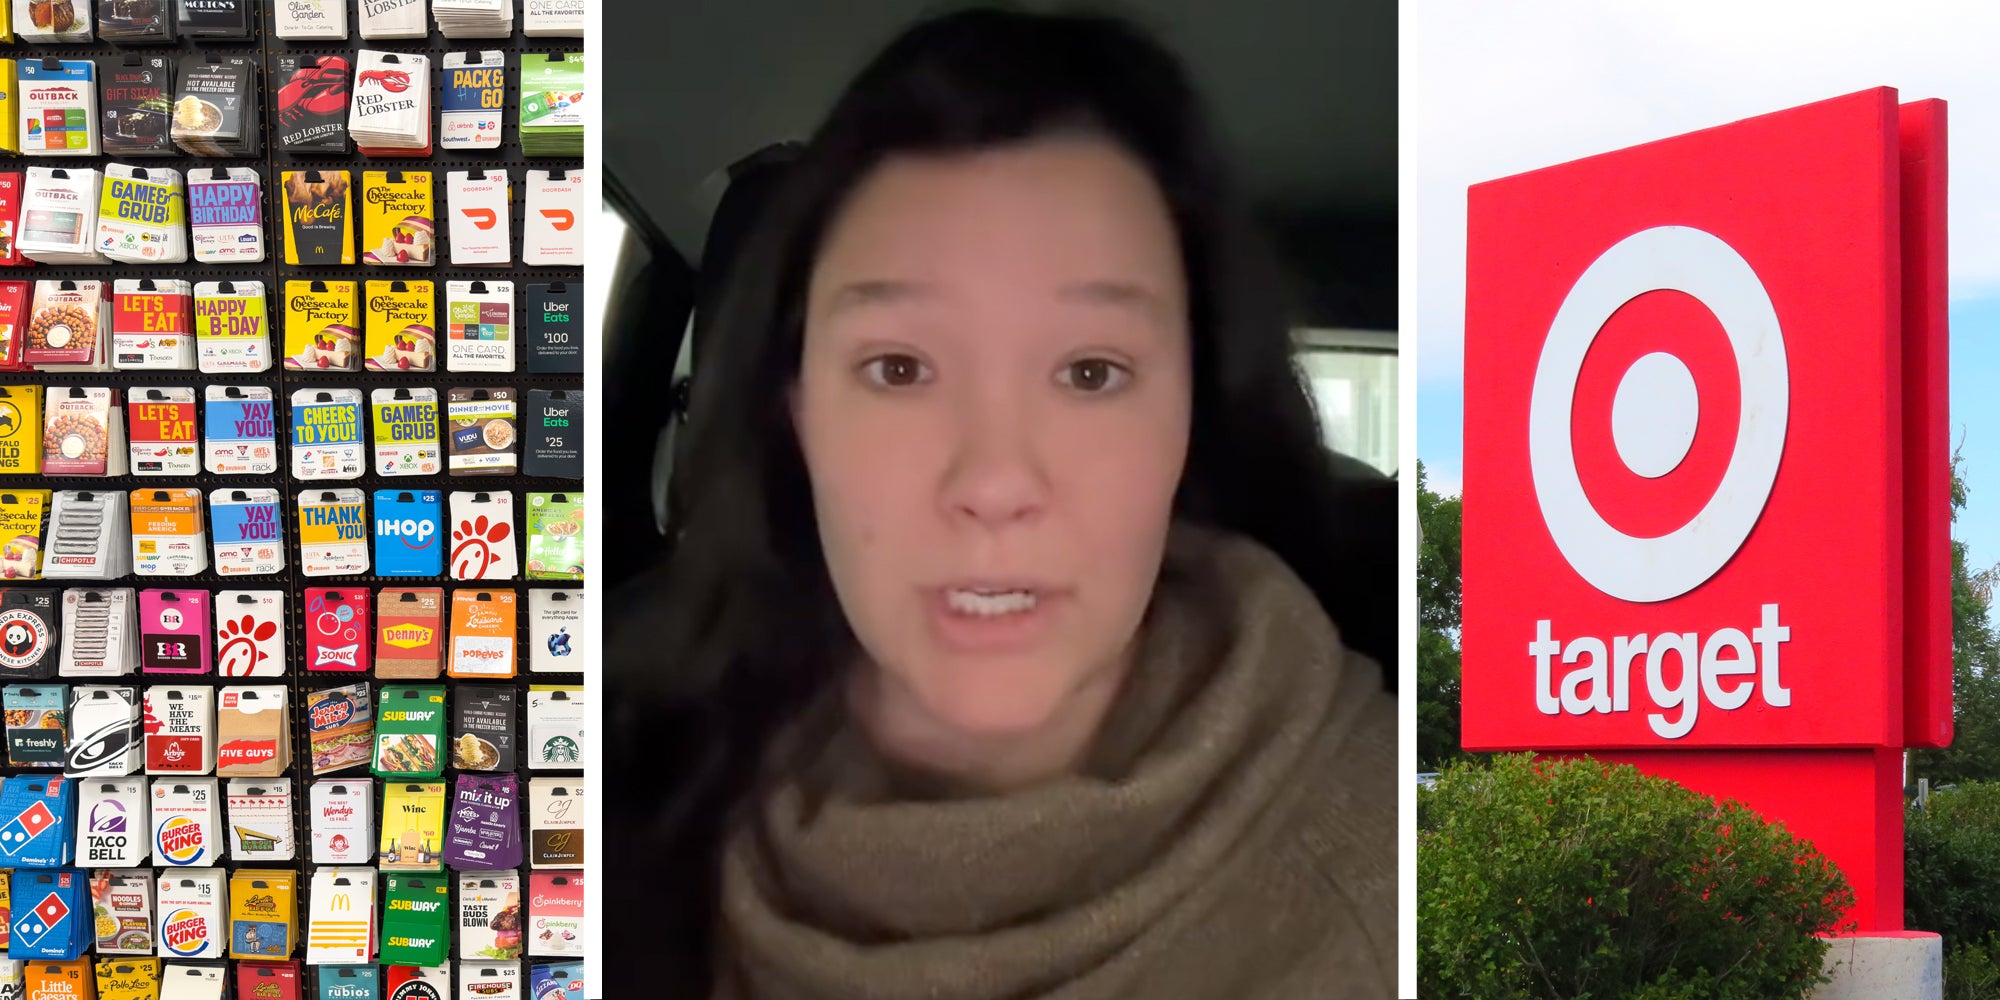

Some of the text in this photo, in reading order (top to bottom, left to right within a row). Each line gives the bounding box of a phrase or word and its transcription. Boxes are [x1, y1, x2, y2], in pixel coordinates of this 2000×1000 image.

[184, 0, 235, 9] MORTON'S
[287, 1, 311, 11] Olive
[529, 0, 584, 10] ONE CARD
[291, 10, 325, 21] Garden
[186, 80, 236, 88] NOT AVAILABLE
[29, 92, 79, 101] OUTBACK
[106, 87, 162, 101] GIFT STEAK
[355, 93, 383, 106] RED
[481, 89, 503, 109] GO
[357, 99, 415, 118] LOBSTER
[282, 122, 344, 146] RED LOBSTER
[410, 175, 427, 184] $50
[490, 175, 503, 183] $50
[569, 176, 582, 184] $25
[35, 191, 79, 201] OUTBACK
[190, 184, 254, 206] HAPPY
[366, 186, 426, 204] Cheesecake
[117, 202, 165, 224] GRUB
[293, 203, 341, 223] McCafé
[383, 200, 425, 215] Factory
[192, 205, 255, 224] BIRTHDAY
[119, 242, 139, 251] XBOX
[335, 285, 350, 293] $25
[414, 285, 429, 293] $25
[123, 295, 164, 312] LET'S
[196, 299, 247, 317] HAPPY
[290, 295, 349, 312] Cheesecake
[369, 295, 428, 312] Cheesecake
[543, 301, 570, 312] Uber
[143, 312, 178, 331] EAT
[306, 309, 348, 323] Factory
[384, 309, 427, 323] Factory
[543, 313, 570, 323] Eats
[210, 316, 260, 336] B-DAY
[544, 332, 568, 344] $100
[452, 344, 474, 354] ONE
[59, 403, 95, 411] OUTBACK
[138, 404, 179, 421] LET'S
[241, 403, 271, 421] YAY
[449, 405, 479, 414] DINNER
[484, 403, 510, 412] MOVIE
[543, 407, 569, 417] Uber
[303, 405, 356, 425] CHEERS
[543, 418, 569, 427] Eats
[159, 421, 194, 440] EAT
[234, 420, 273, 438] YOU!
[296, 422, 357, 443] TO YOU!
[391, 423, 436, 441] GRUB
[458, 433, 478, 443] VUDU
[545, 437, 563, 447] $25
[252, 463, 272, 472] rack
[244, 505, 274, 523] YAY
[302, 506, 362, 526] THANK
[238, 523, 277, 540] YOU!
[60, 557, 96, 565] CHIPOTLE
[255, 563, 276, 573] rack
[35, 597, 50, 605] $25
[421, 598, 435, 606] $25
[500, 595, 513, 603] $25
[17, 612, 45, 638] EXPRESS
[386, 628, 430, 643] Denny's
[17, 647, 42, 665] KITCHEN
[320, 651, 353, 660] SONIC
[1528, 603, 1791, 739] target
[169, 703, 184, 711] WE
[311, 701, 349, 719] Jersey
[314, 711, 350, 729] Mike's
[381, 710, 435, 722] SUBWAY
[463, 716, 475, 724] NOT
[476, 717, 507, 726] AVAILABLE
[169, 725, 201, 733] MEATS
[324, 722, 340, 730] SUBS
[26, 738, 58, 748] freshly
[163, 748, 186, 757] Arby's
[220, 749, 274, 757] FIVE GUYS
[126, 786, 137, 794] $15
[427, 785, 442, 793] $60
[192, 790, 206, 801] $25
[459, 789, 482, 802] mix
[483, 793, 493, 804] it
[493, 796, 510, 810] up
[323, 807, 354, 818] Wendy's
[402, 804, 426, 814] Winc
[161, 823, 201, 842] BURGER
[86, 835, 127, 848] TACO
[163, 834, 203, 855] KING
[21, 856, 48, 864] Domino's
[89, 848, 126, 861] BELL
[197, 883, 211, 895] $15
[502, 882, 513, 890] $25
[112, 895, 141, 903] NOODLES
[543, 898, 582, 908] pinkberry
[388, 899, 441, 913] SUBWAY
[167, 917, 205, 934] BURGER
[462, 918, 489, 928] BLOWN
[545, 920, 578, 929] pinkberry
[168, 926, 207, 948] KING
[387, 936, 435, 949] SUBWAY
[139, 964, 153, 972] $25
[67, 970, 79, 979] $15
[40, 980, 73, 994] Little
[110, 979, 130, 990] Pollo
[130, 978, 150, 990] Loco
[468, 982, 512, 990] FIREHOUSE
[31, 991, 78, 1000] Caesars
[328, 986, 370, 997] rubio's
